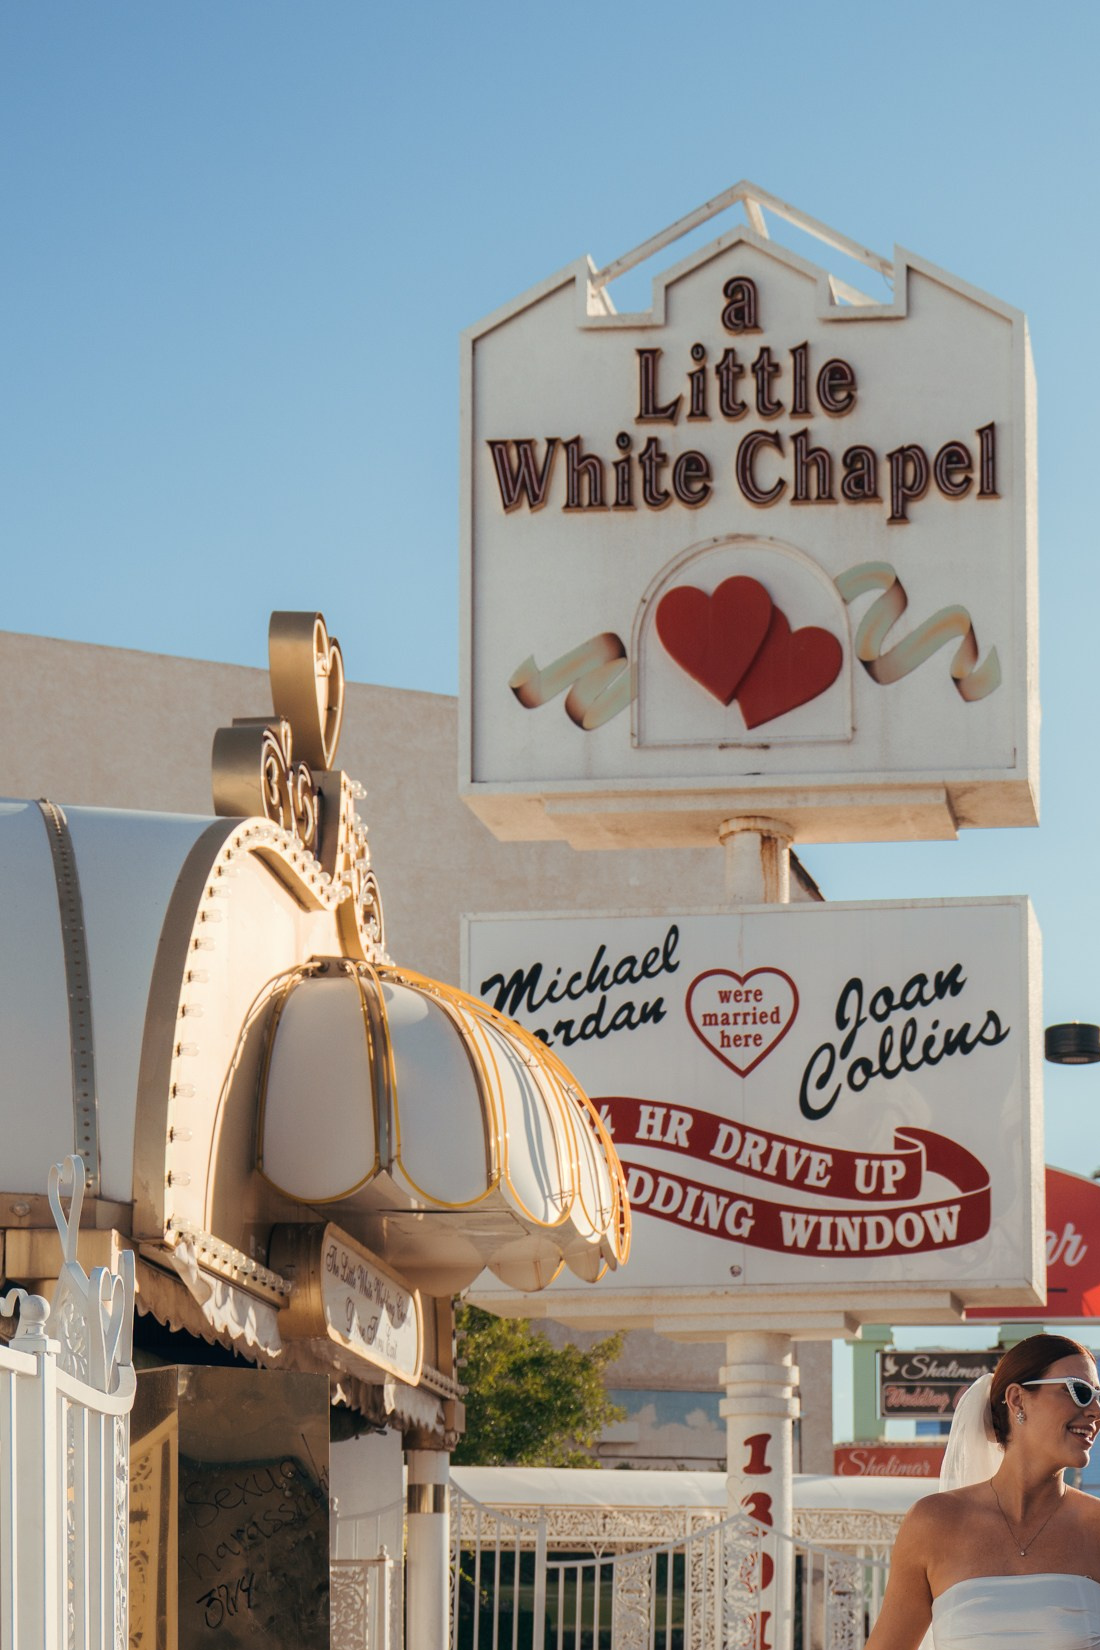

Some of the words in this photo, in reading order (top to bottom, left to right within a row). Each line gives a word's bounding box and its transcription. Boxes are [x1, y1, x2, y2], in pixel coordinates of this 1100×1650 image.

[721, 276, 760, 334] a
[635, 342, 857, 426] Little
[486, 432, 713, 514] White
[735, 421, 1002, 525] Chapel
[480, 924, 681, 1016] Michael
[718, 988, 763, 1005] were
[511, 994, 667, 1048] ordan
[702, 1007, 781, 1026] married
[720, 1030, 763, 1048] here
[835, 963, 967, 1060] Joan
[799, 1010, 1011, 1120] Collins
[635, 1104, 694, 1148] HR
[709, 1123, 833, 1189] DRIVE
[854, 1158, 907, 1196] UP
[626, 1167, 756, 1239] DDING
[779, 1204, 962, 1252] WINDOW
[901, 1355, 989, 1380] Shalimar
[838, 1450, 931, 1476] Shalimar
